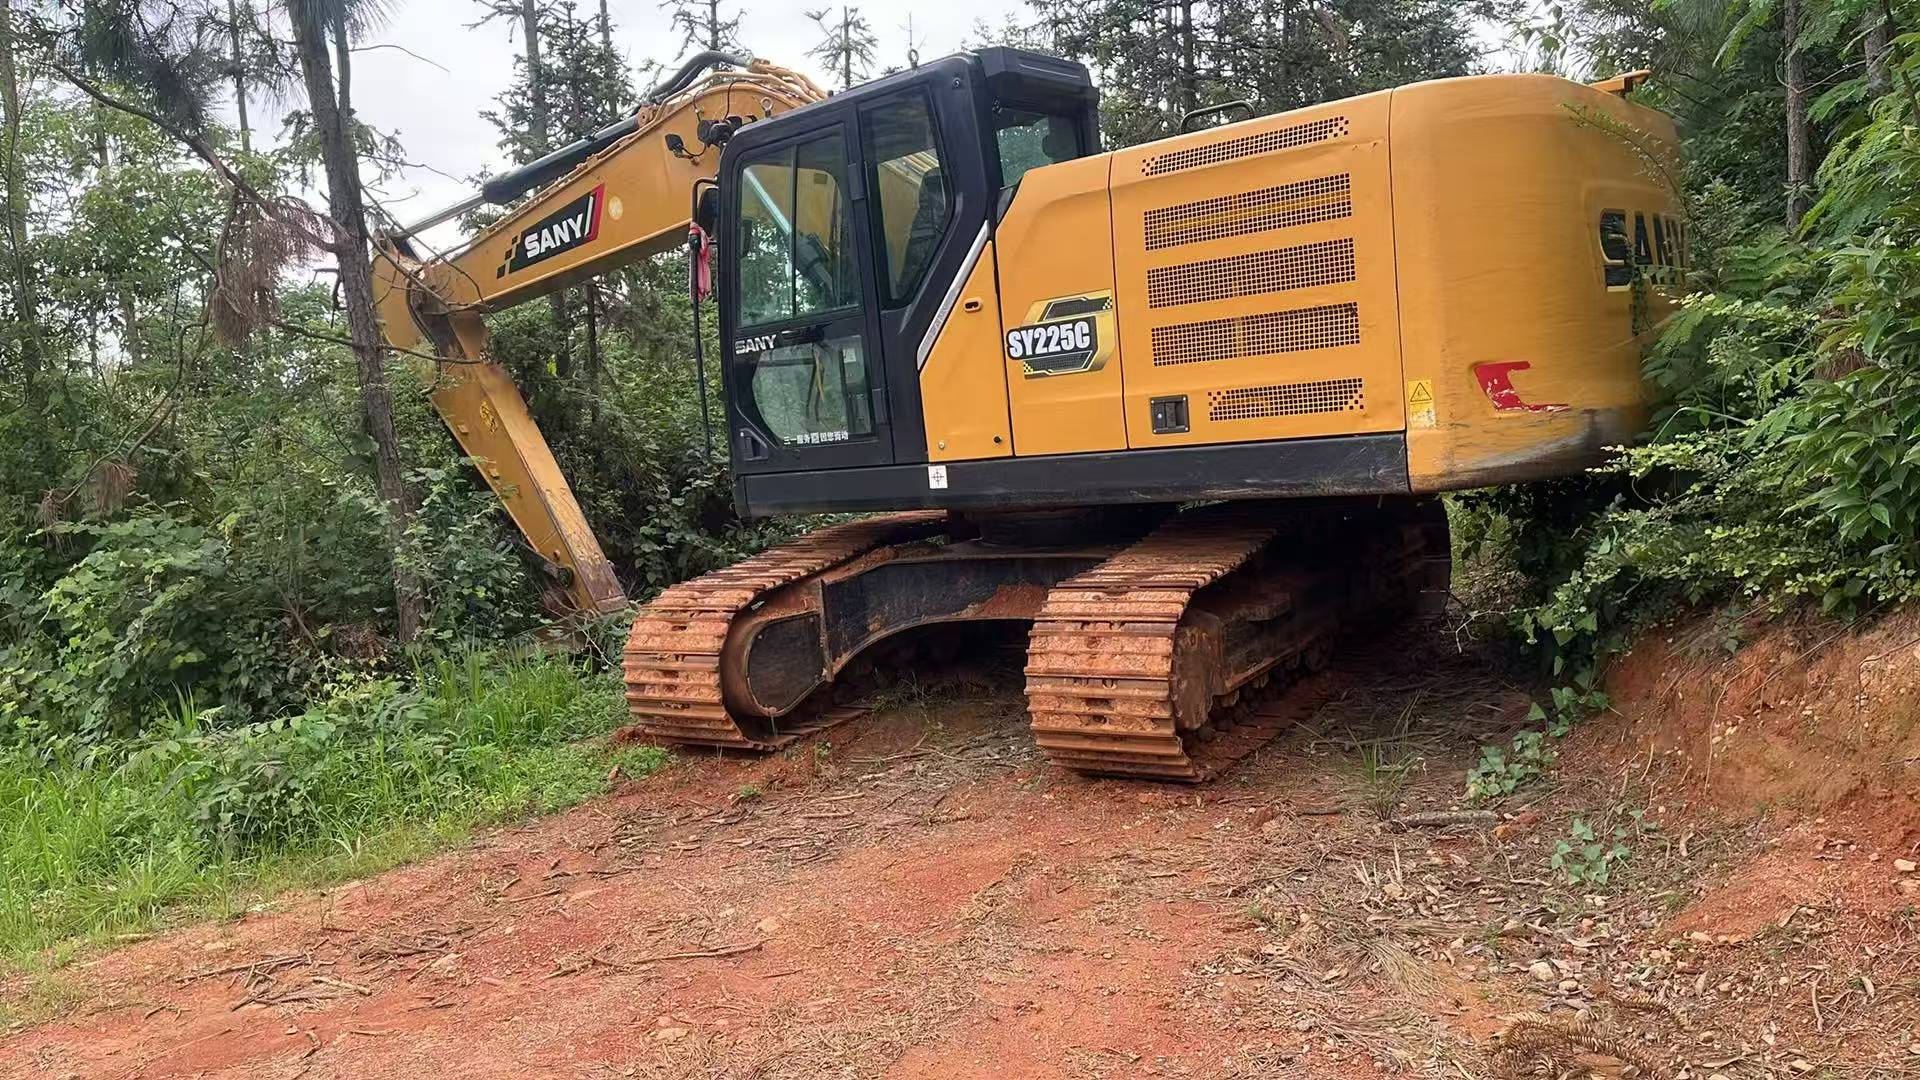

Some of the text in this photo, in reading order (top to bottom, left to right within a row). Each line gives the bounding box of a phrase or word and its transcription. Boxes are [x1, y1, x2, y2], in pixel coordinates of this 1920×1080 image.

[524, 213, 583, 258] SANY
[735, 334, 776, 355] SANY
[1008, 321, 1091, 358] SY225C
